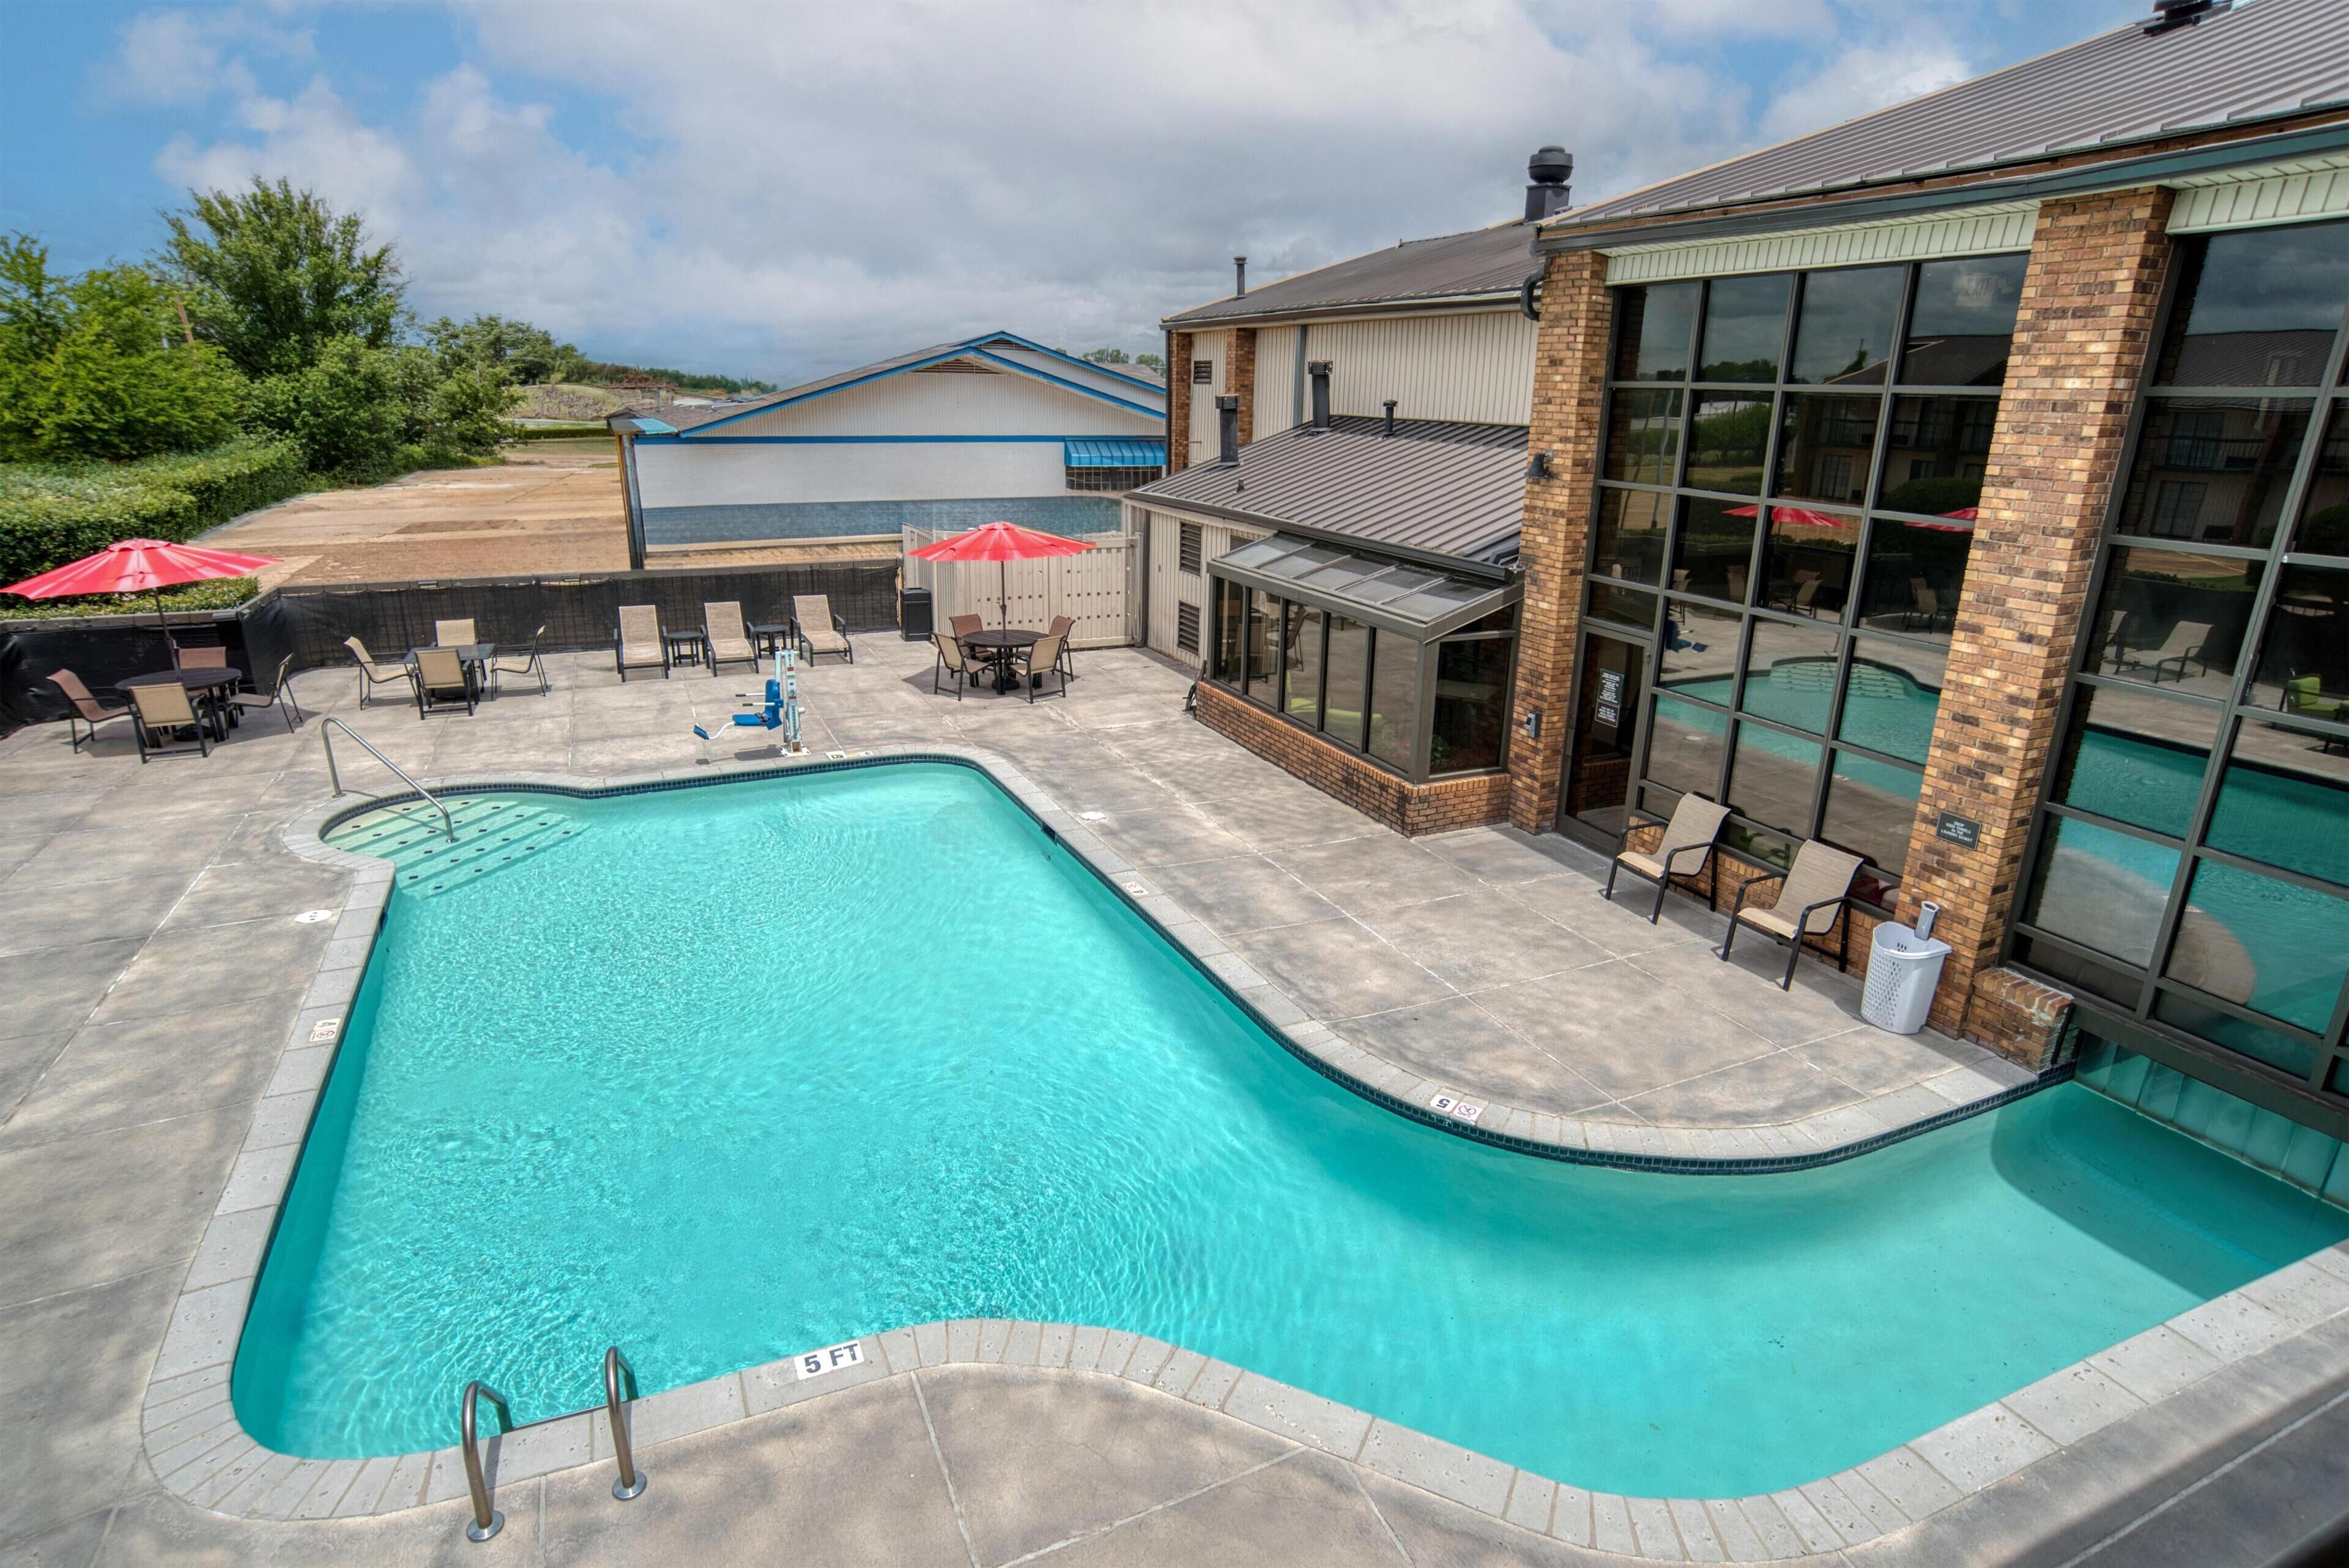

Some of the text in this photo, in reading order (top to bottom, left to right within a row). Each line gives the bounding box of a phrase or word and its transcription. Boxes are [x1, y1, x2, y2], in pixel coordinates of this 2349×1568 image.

[1965, 277, 1992, 297] EXIT
[1941, 828, 1958, 838] LAUNDRY
[1956, 825, 1971, 834] TOWELS
[1436, 1098, 1450, 1109] 5
[804, 1343, 858, 1373] 5 FT
